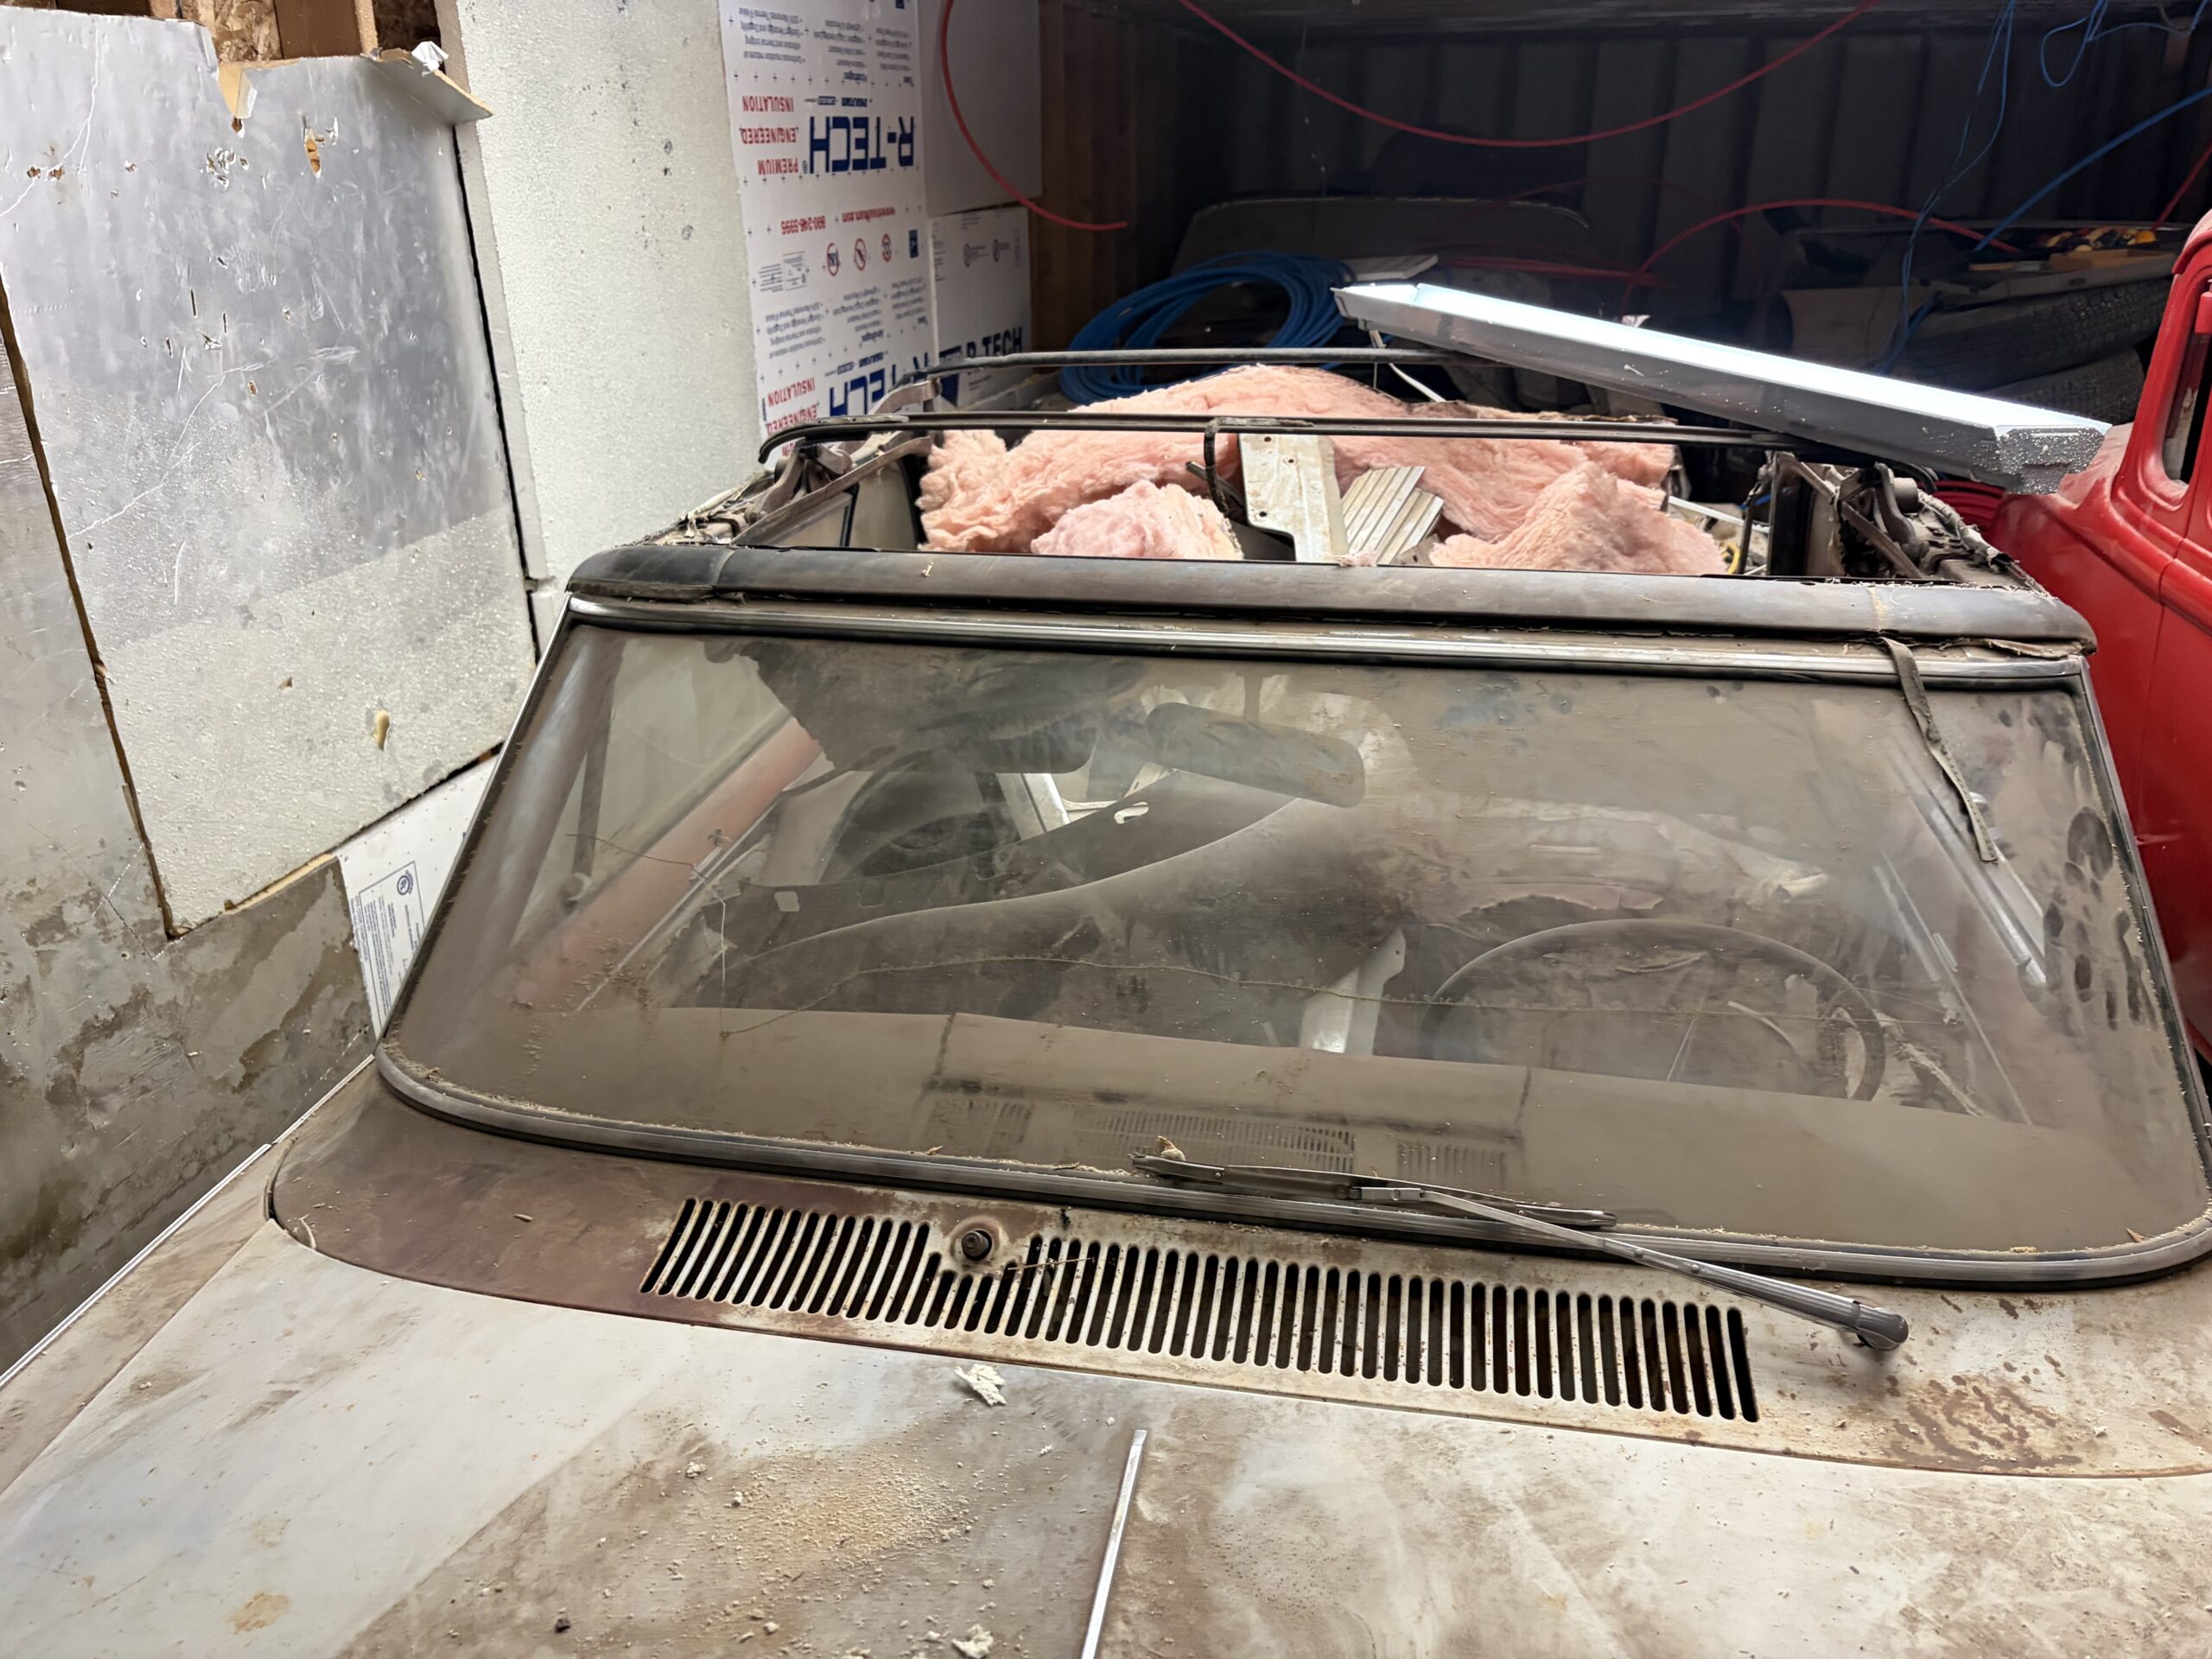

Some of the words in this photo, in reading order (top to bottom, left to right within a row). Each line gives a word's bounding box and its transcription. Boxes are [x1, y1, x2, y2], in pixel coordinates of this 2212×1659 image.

[741, 96, 794, 112] INSULATION
[741, 127, 798, 145] ENGINEERED
[810, 116, 915, 175] R-TECH
[757, 158, 798, 175] PREMIUM
[767, 378, 816, 407] INSULATION
